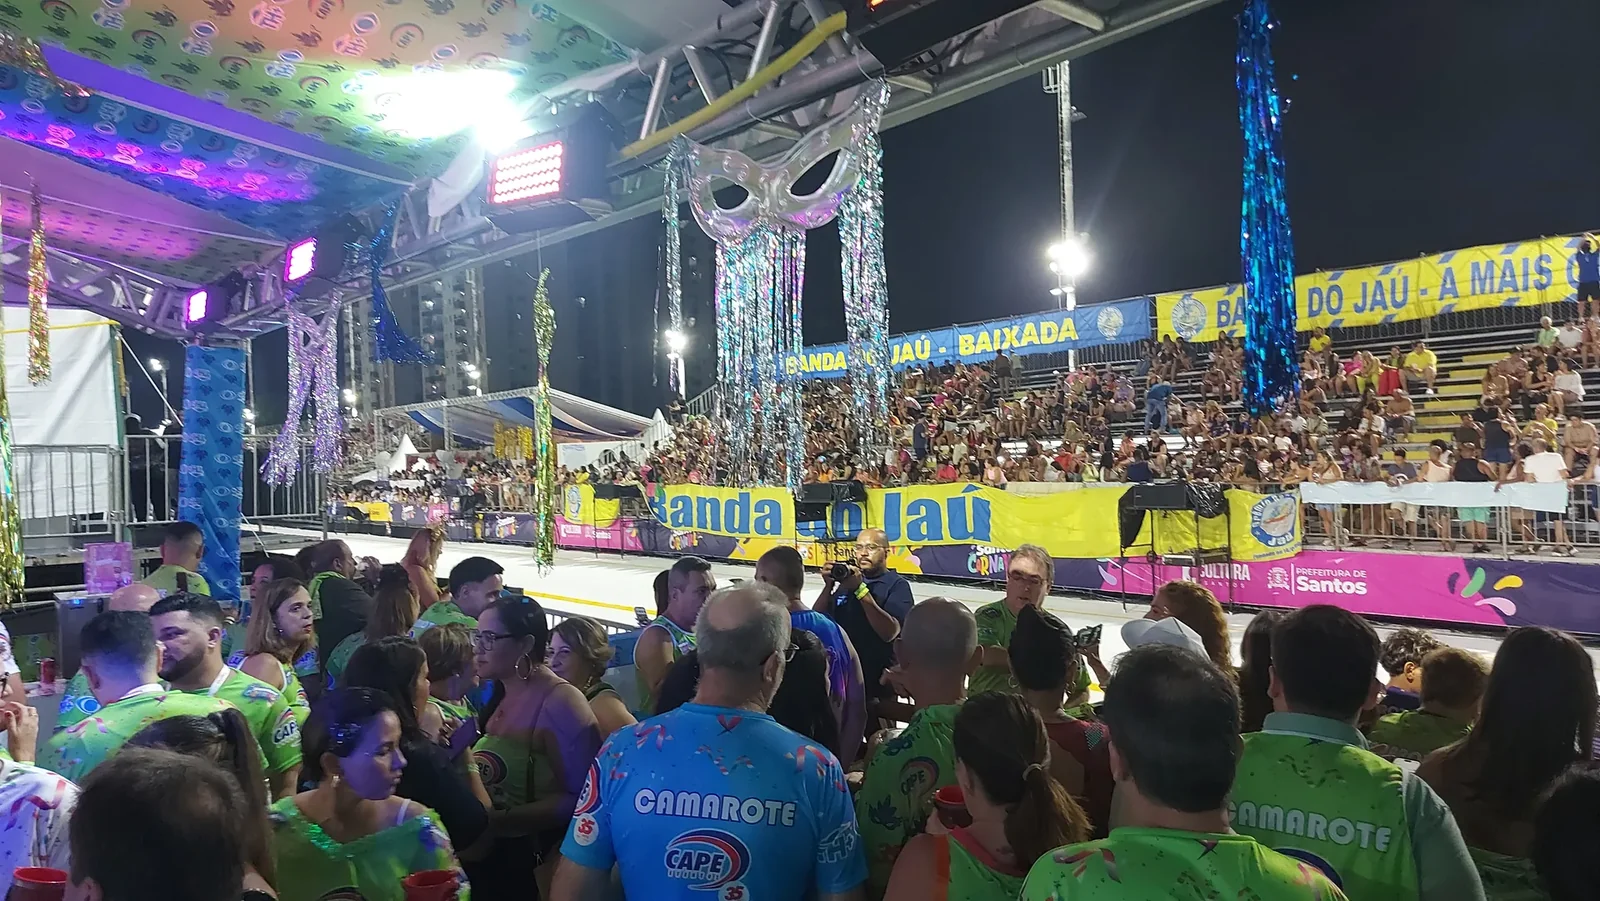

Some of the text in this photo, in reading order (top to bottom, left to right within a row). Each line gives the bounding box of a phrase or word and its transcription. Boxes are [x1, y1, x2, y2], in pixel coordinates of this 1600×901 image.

[1307, 284, 1344, 318] DO
[1438, 266, 1460, 301] A
[1470, 254, 1553, 296] MAIS
[957, 316, 1080, 357] BAIXADA
[883, 484, 991, 543] Jaú
[1295, 567, 1367, 579] PREFEITURA DE
[1296, 575, 1367, 595] Santos
[273, 721, 298, 744] CAP
[634, 788, 798, 827] CAMAROTE
[664, 847, 727, 874] CAPE
